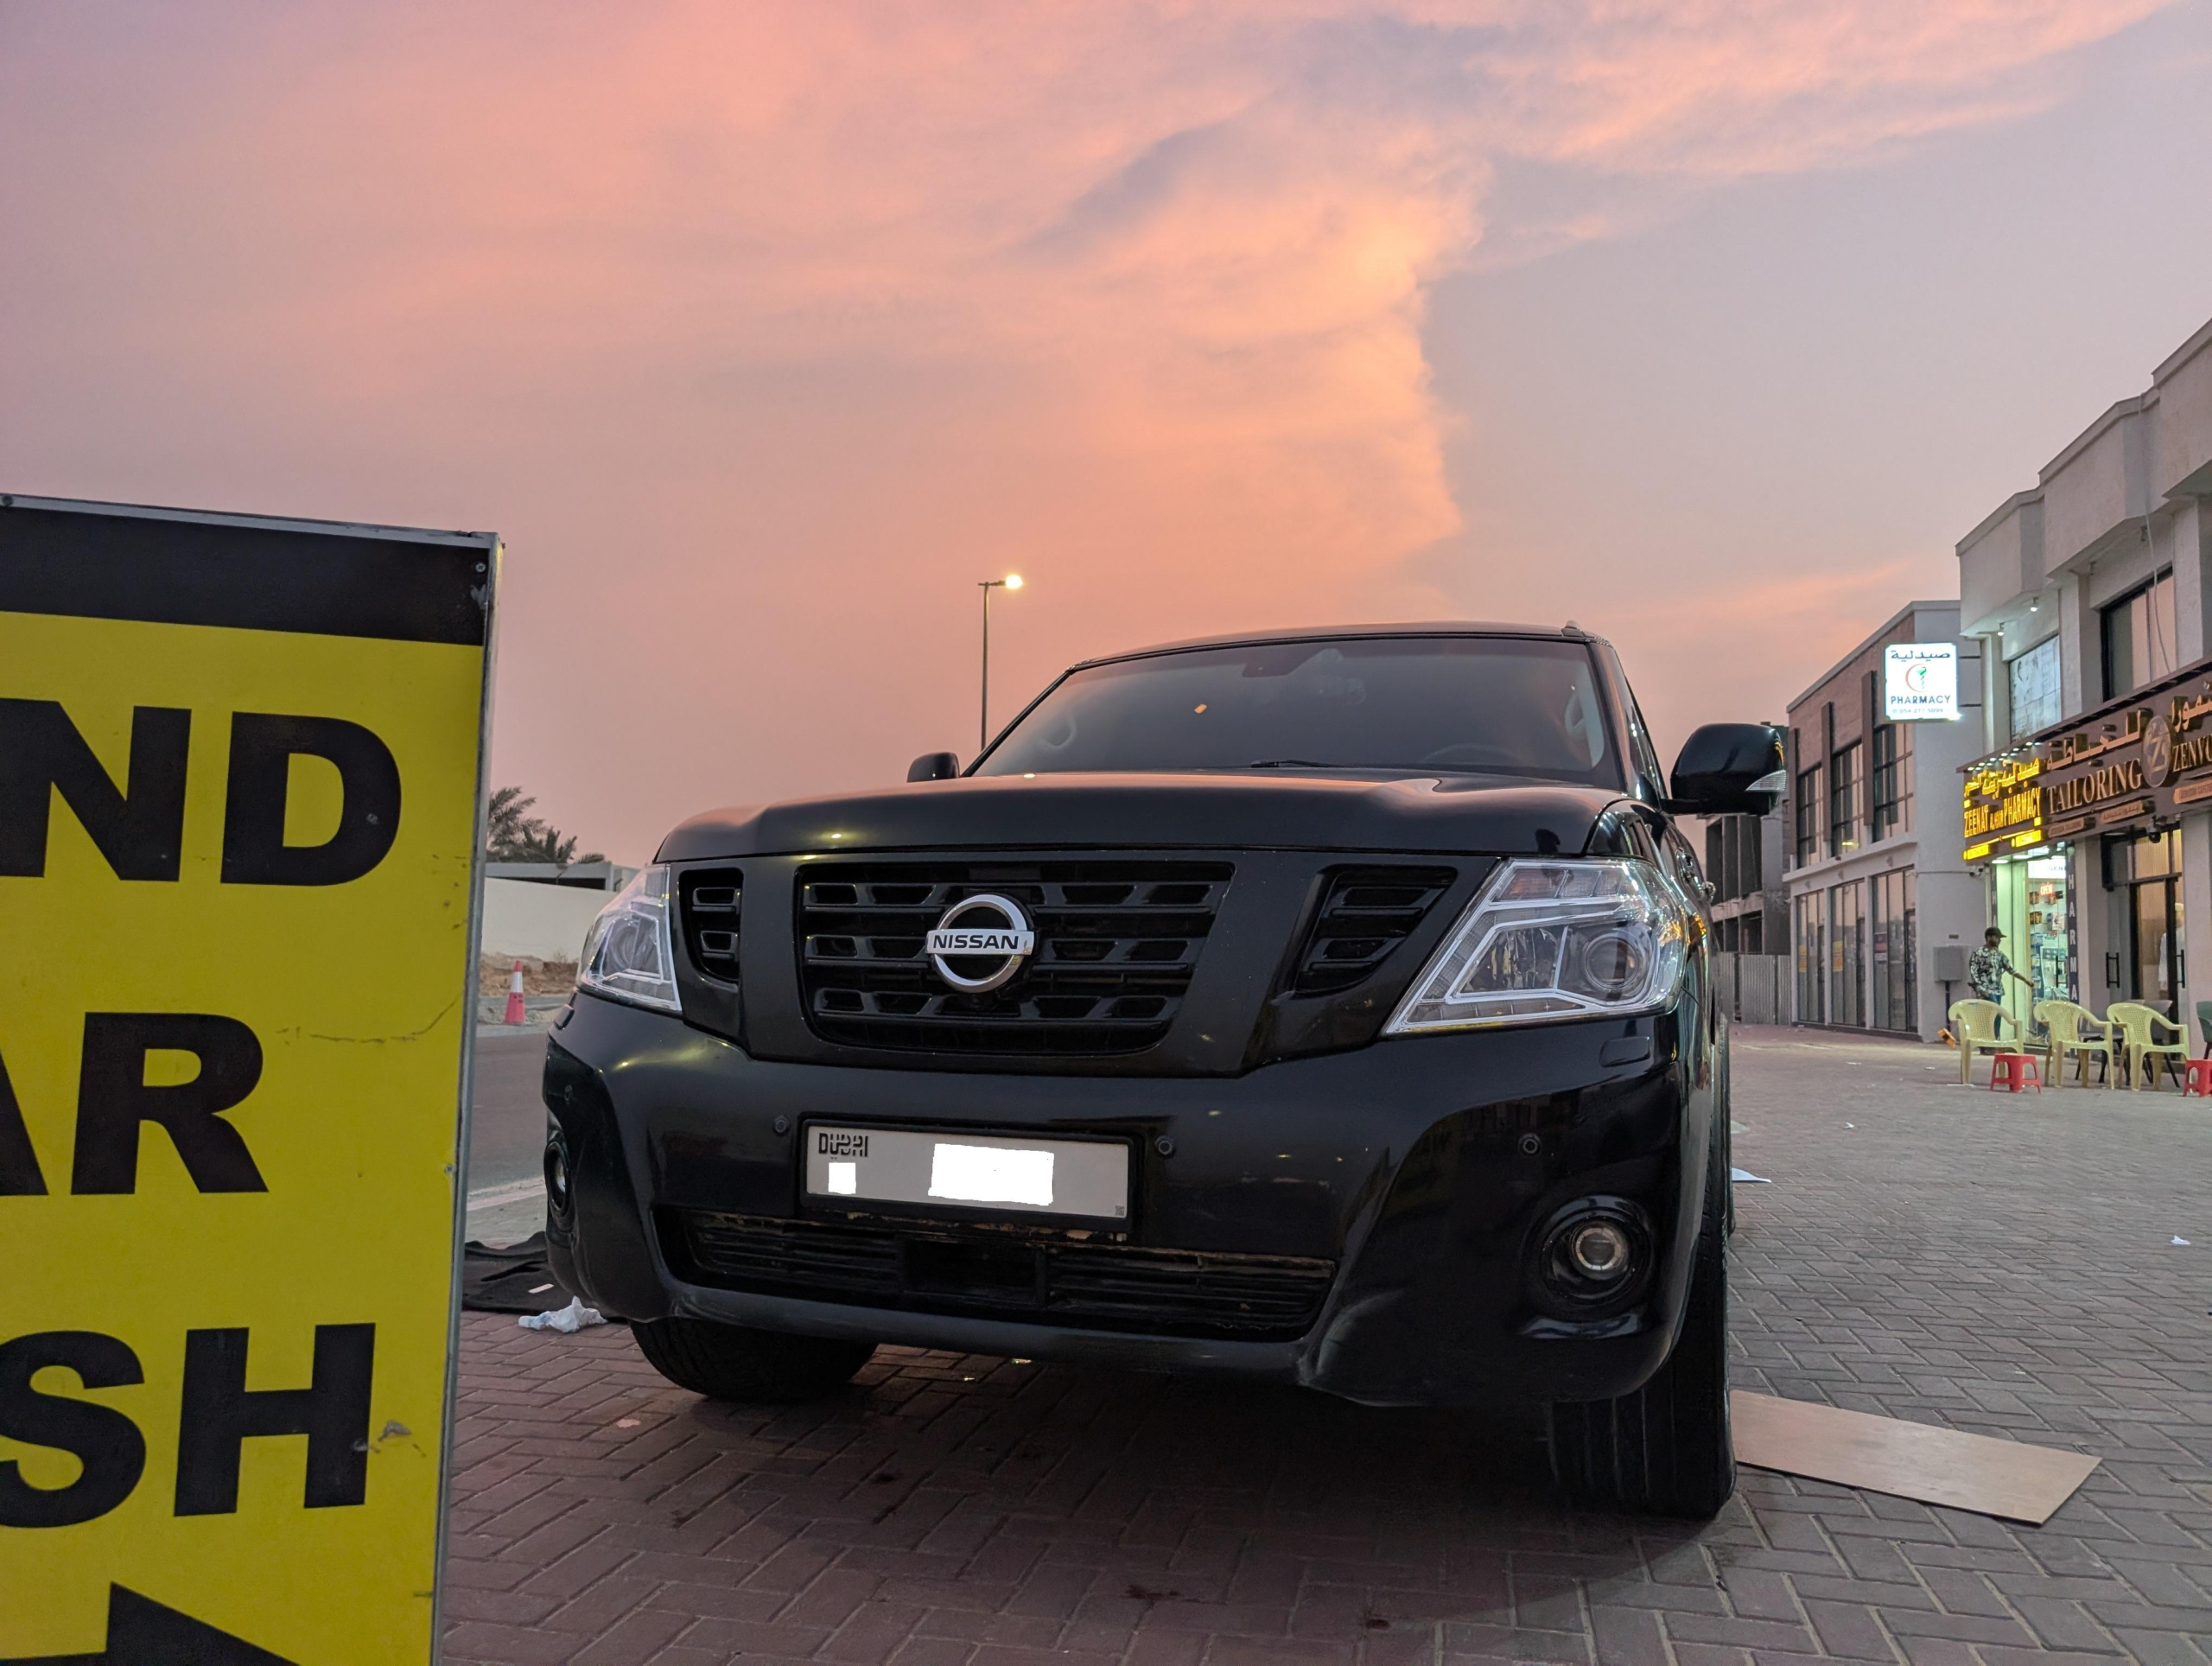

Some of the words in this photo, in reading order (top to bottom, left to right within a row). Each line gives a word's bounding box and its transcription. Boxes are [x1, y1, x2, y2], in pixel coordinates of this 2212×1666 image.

[1891, 650, 1950, 662] صيدلية
[1891, 695, 1950, 704] PHARMACY
[2047, 710, 2140, 771] للخياطة
[2047, 758, 2142, 815] TAILORING
[1964, 804, 1989, 837] ZEENAT
[2004, 786, 2041, 827] PHARMACY
[933, 934, 1019, 950] NISSAN
